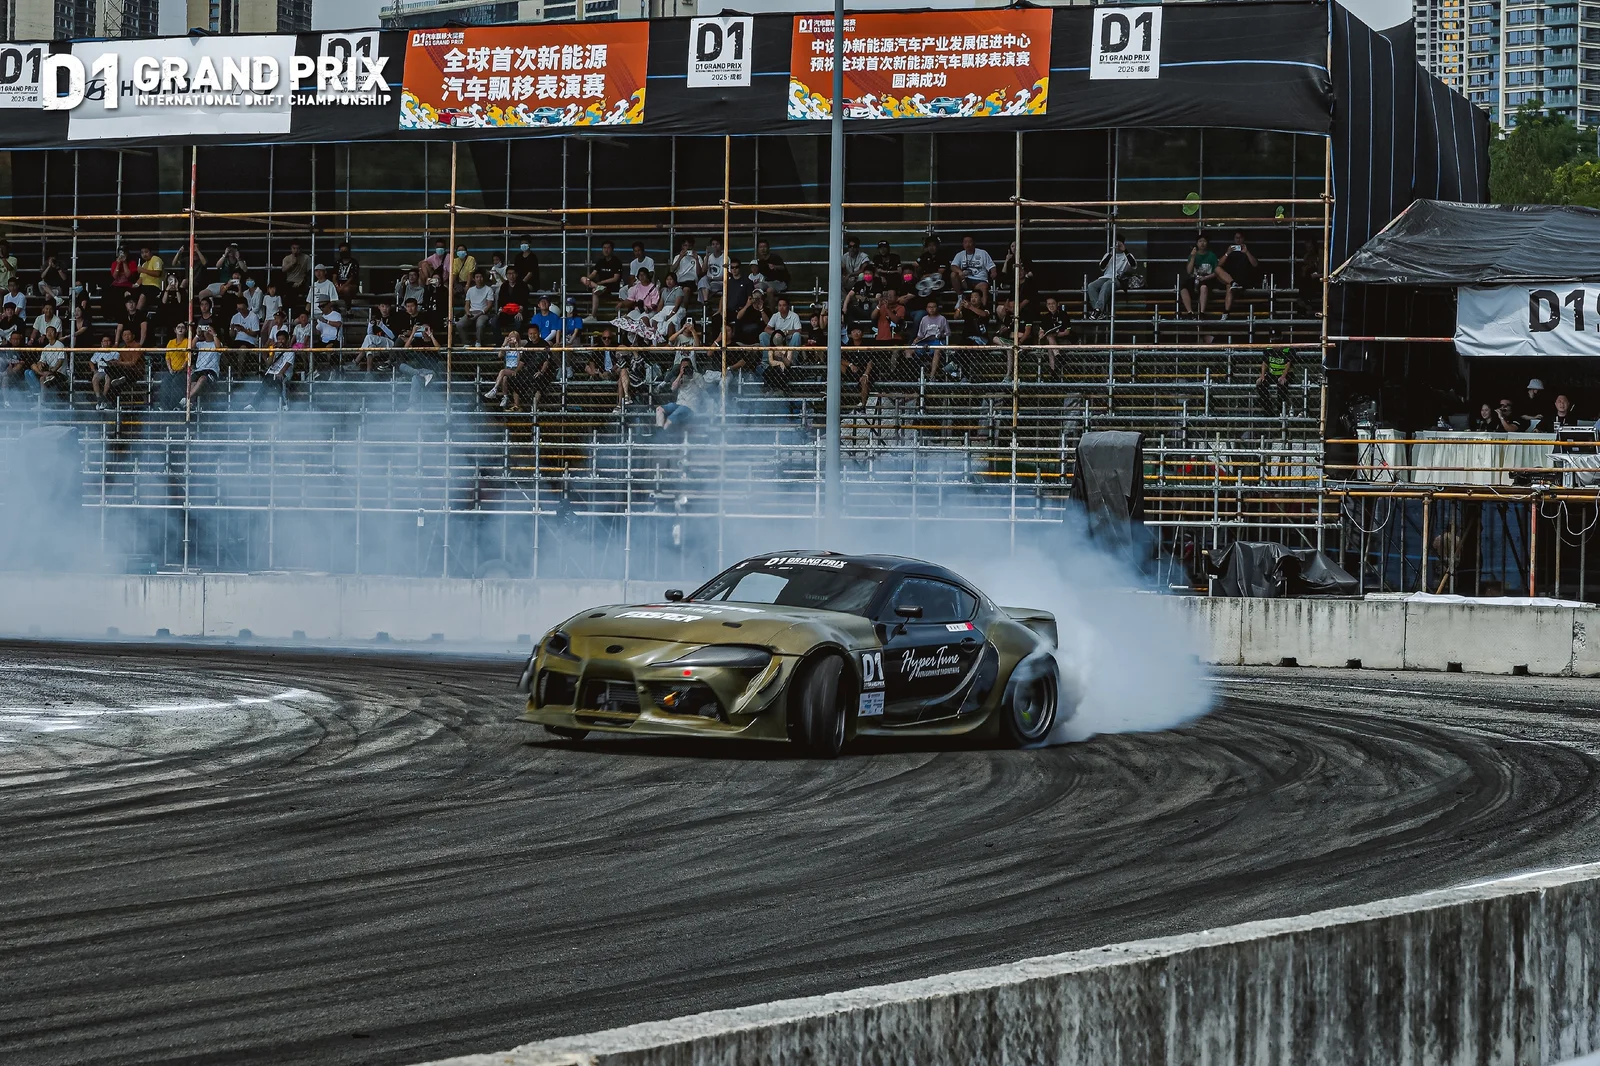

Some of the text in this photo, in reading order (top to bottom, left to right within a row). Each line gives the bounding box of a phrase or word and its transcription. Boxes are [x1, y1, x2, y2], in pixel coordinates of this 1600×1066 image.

[412, 32, 426, 44] D1
[799, 19, 812, 31] D1
[1101, 12, 1153, 53] D1
[696, 22, 744, 62] D1
[0, 48, 42, 84] D1
[443, 44, 608, 73] 全球首次新能源
[441, 72, 606, 102] 汽车飘移表演赛
[892, 72, 947, 88] 圆满成功
[1529, 289, 1585, 332] D1
[764, 557, 848, 569] D1 GRAND PRIX
[862, 652, 884, 682] D1
[901, 649, 936, 682] Hyper
[936, 645, 960, 669] Tune
